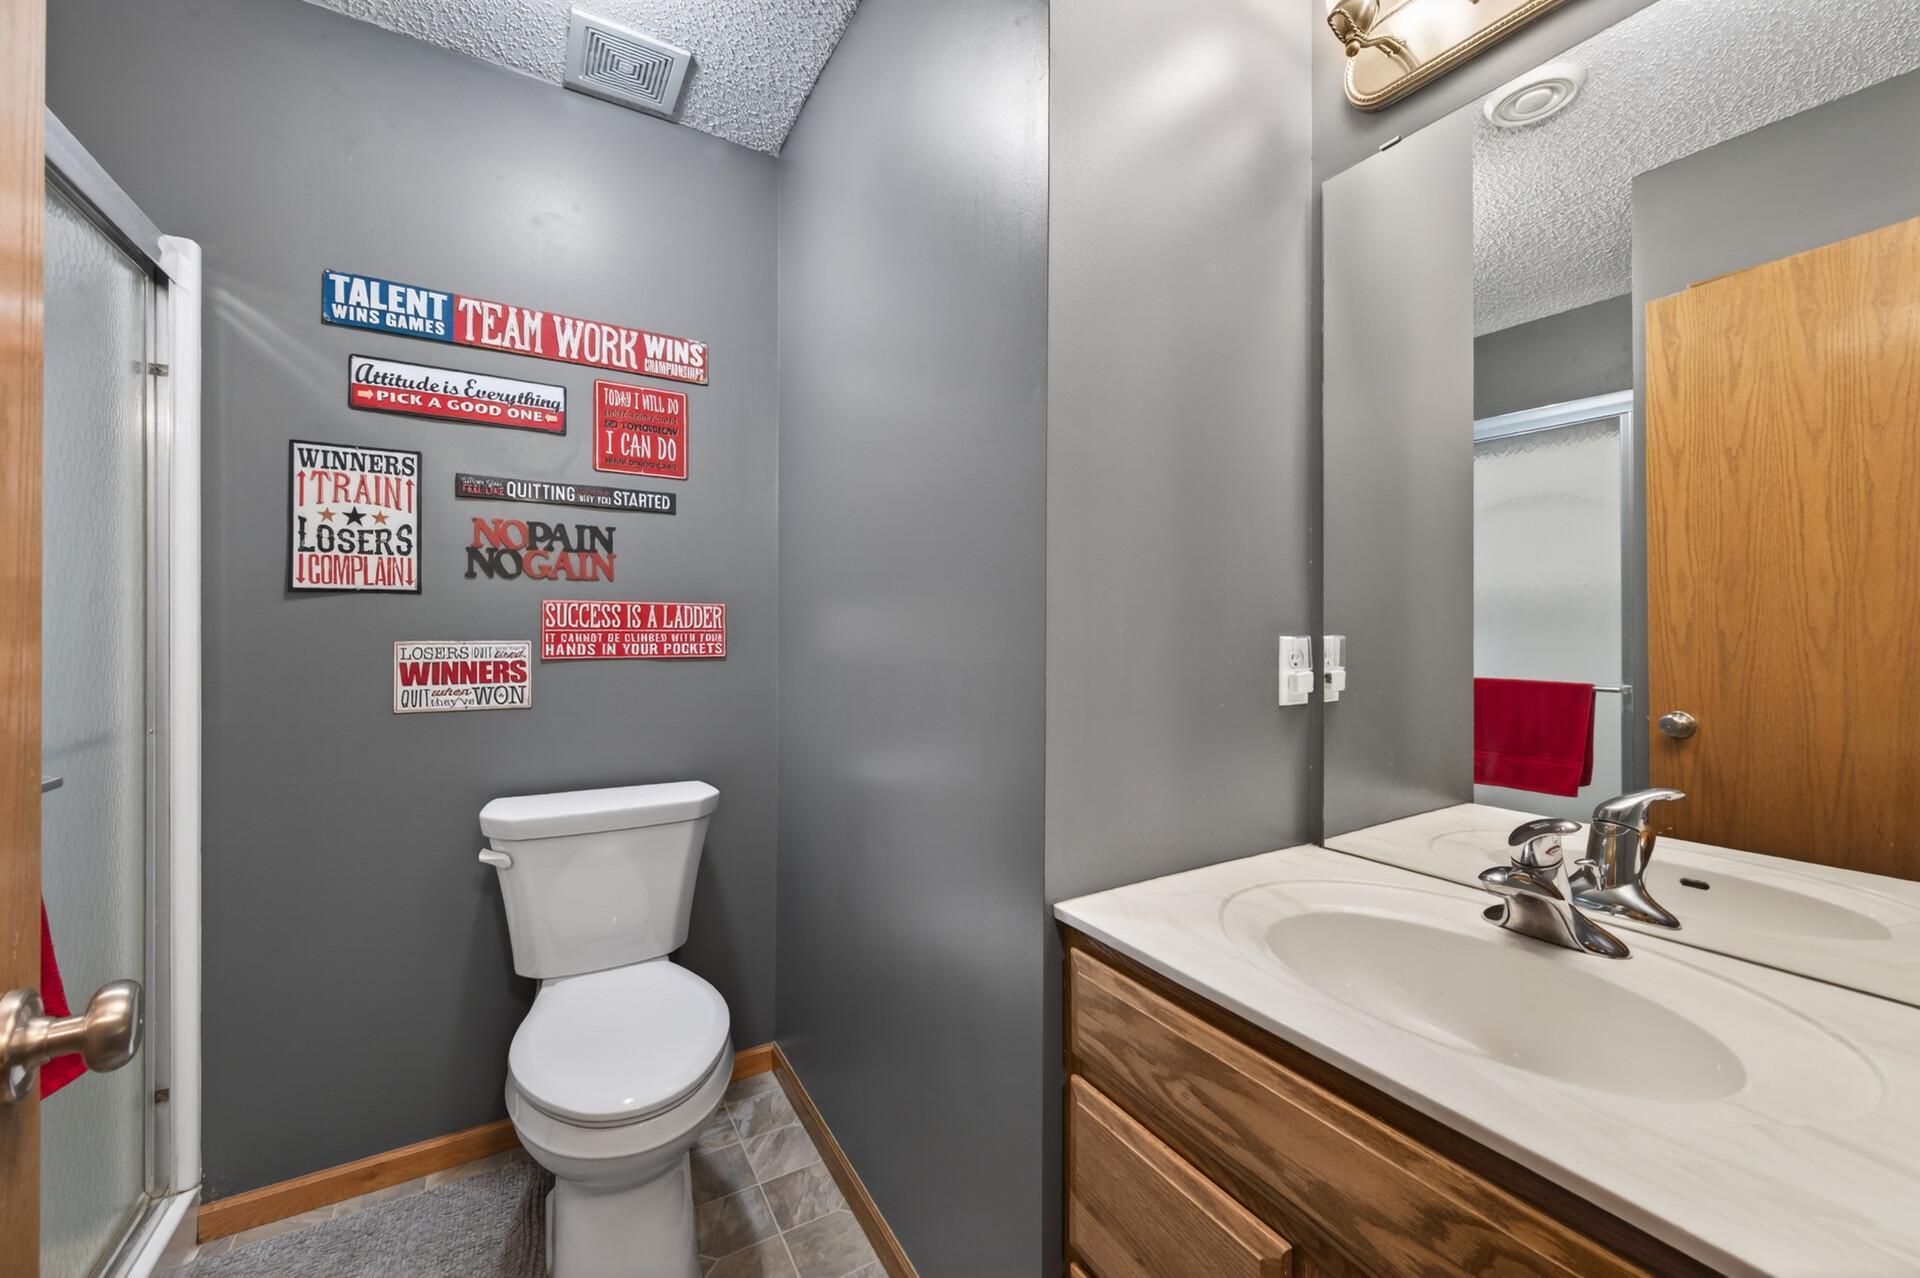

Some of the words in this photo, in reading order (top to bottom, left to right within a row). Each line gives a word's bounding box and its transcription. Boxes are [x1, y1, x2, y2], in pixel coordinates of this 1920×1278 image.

[329, 274, 448, 321] TALENT
[331, 303, 380, 325] WINS
[386, 313, 445, 336] GAMES
[458, 297, 544, 354] TEAM
[552, 315, 639, 370] WORK
[643, 333, 704, 367] WINS
[355, 363, 440, 392] Attitude
[443, 380, 458, 395] is
[464, 378, 563, 413] Everything
[604, 388, 631, 407] TODAY
[634, 393, 639, 410] I
[642, 394, 664, 413] WILL
[668, 398, 679, 415] DO
[376, 390, 423, 406] PICK
[428, 397, 442, 409] A
[447, 400, 502, 416] GOOD
[507, 408, 544, 422] ONE
[605, 430, 614, 454] I
[621, 432, 651, 459] CAN
[657, 437, 677, 461] DO
[297, 448, 415, 477] WINNERS
[310, 470, 402, 511] TRAIN
[506, 480, 576, 502] QUITTING
[613, 490, 671, 510] STARTED
[297, 515, 413, 556] LOSERS
[470, 517, 528, 550] NO
[526, 521, 616, 553] PAIN
[308, 554, 404, 586] COMPLAIN
[465, 546, 523, 579] NO
[523, 550, 617, 582] GAIN
[545, 603, 621, 628] SUCCESS
[627, 604, 642, 628] IS
[648, 605, 657, 628] A
[663, 605, 722, 629] LADDER
[400, 647, 469, 660] LOSERS
[545, 633, 555, 643] IT
[561, 633, 602, 643] CANNOT
[608, 633, 620, 643] BE
[671, 633, 695, 643] WITH
[545, 643, 596, 656] HANDS
[602, 644, 616, 655] IN
[623, 643, 658, 655] YOUR
[663, 643, 723, 655] POCKETS
[399, 659, 528, 687] WINNERS
[401, 688, 430, 708] QUIT
[431, 687, 472, 697] when
[472, 685, 528, 705] WON
